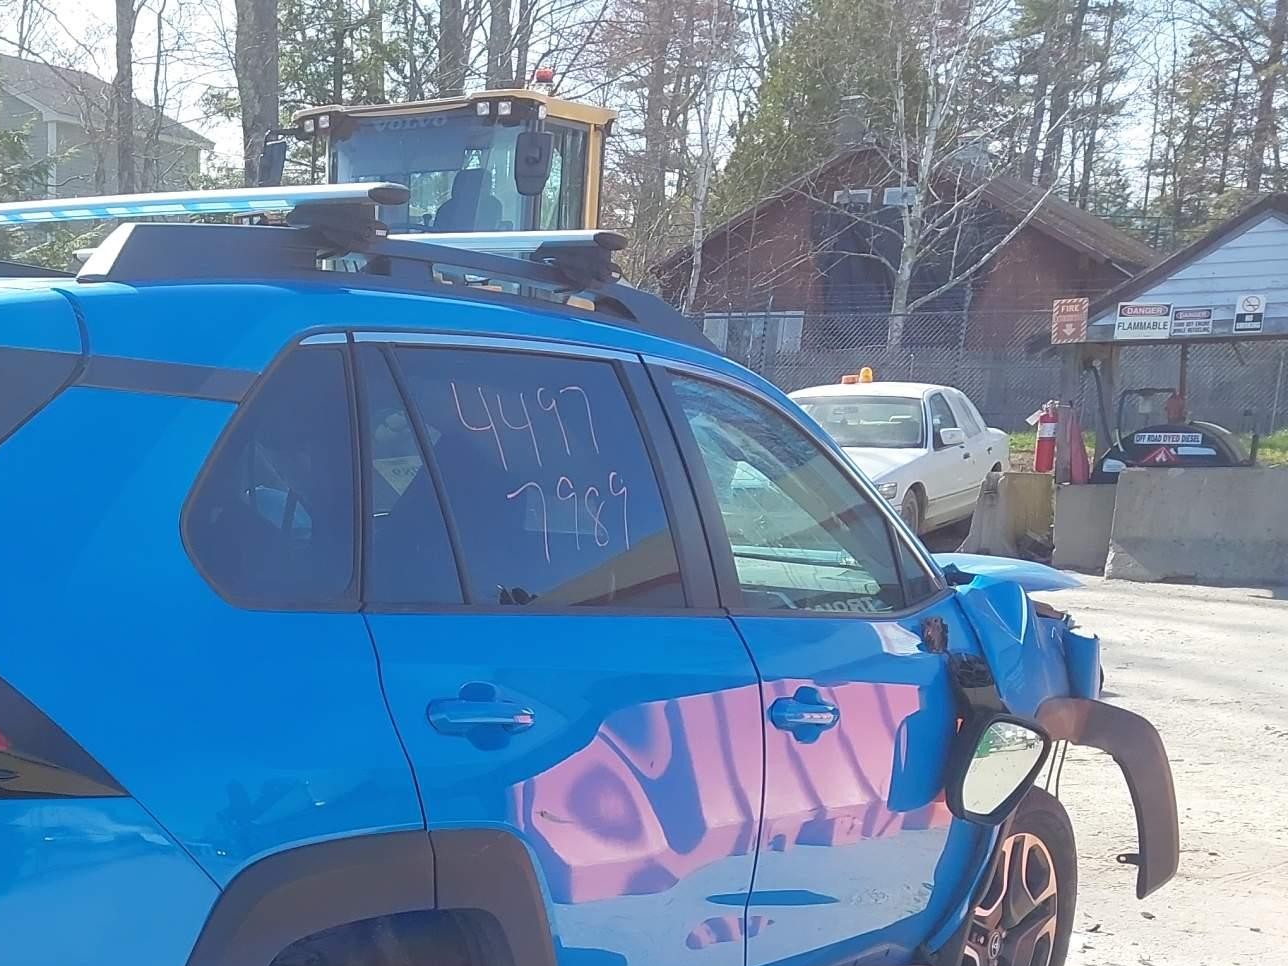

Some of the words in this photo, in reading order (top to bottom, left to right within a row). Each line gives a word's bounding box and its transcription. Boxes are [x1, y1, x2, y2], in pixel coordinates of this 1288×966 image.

[372, 115, 448, 132] VOLVO
[1061, 304, 1080, 313] FIRE
[1127, 306, 1162, 315] DANGER
[1117, 321, 1168, 331] FLAMMABLE
[450, 382, 600, 471] 4497
[1181, 434, 1201, 443] DIESEL
[506, 471, 630, 564] 7989
